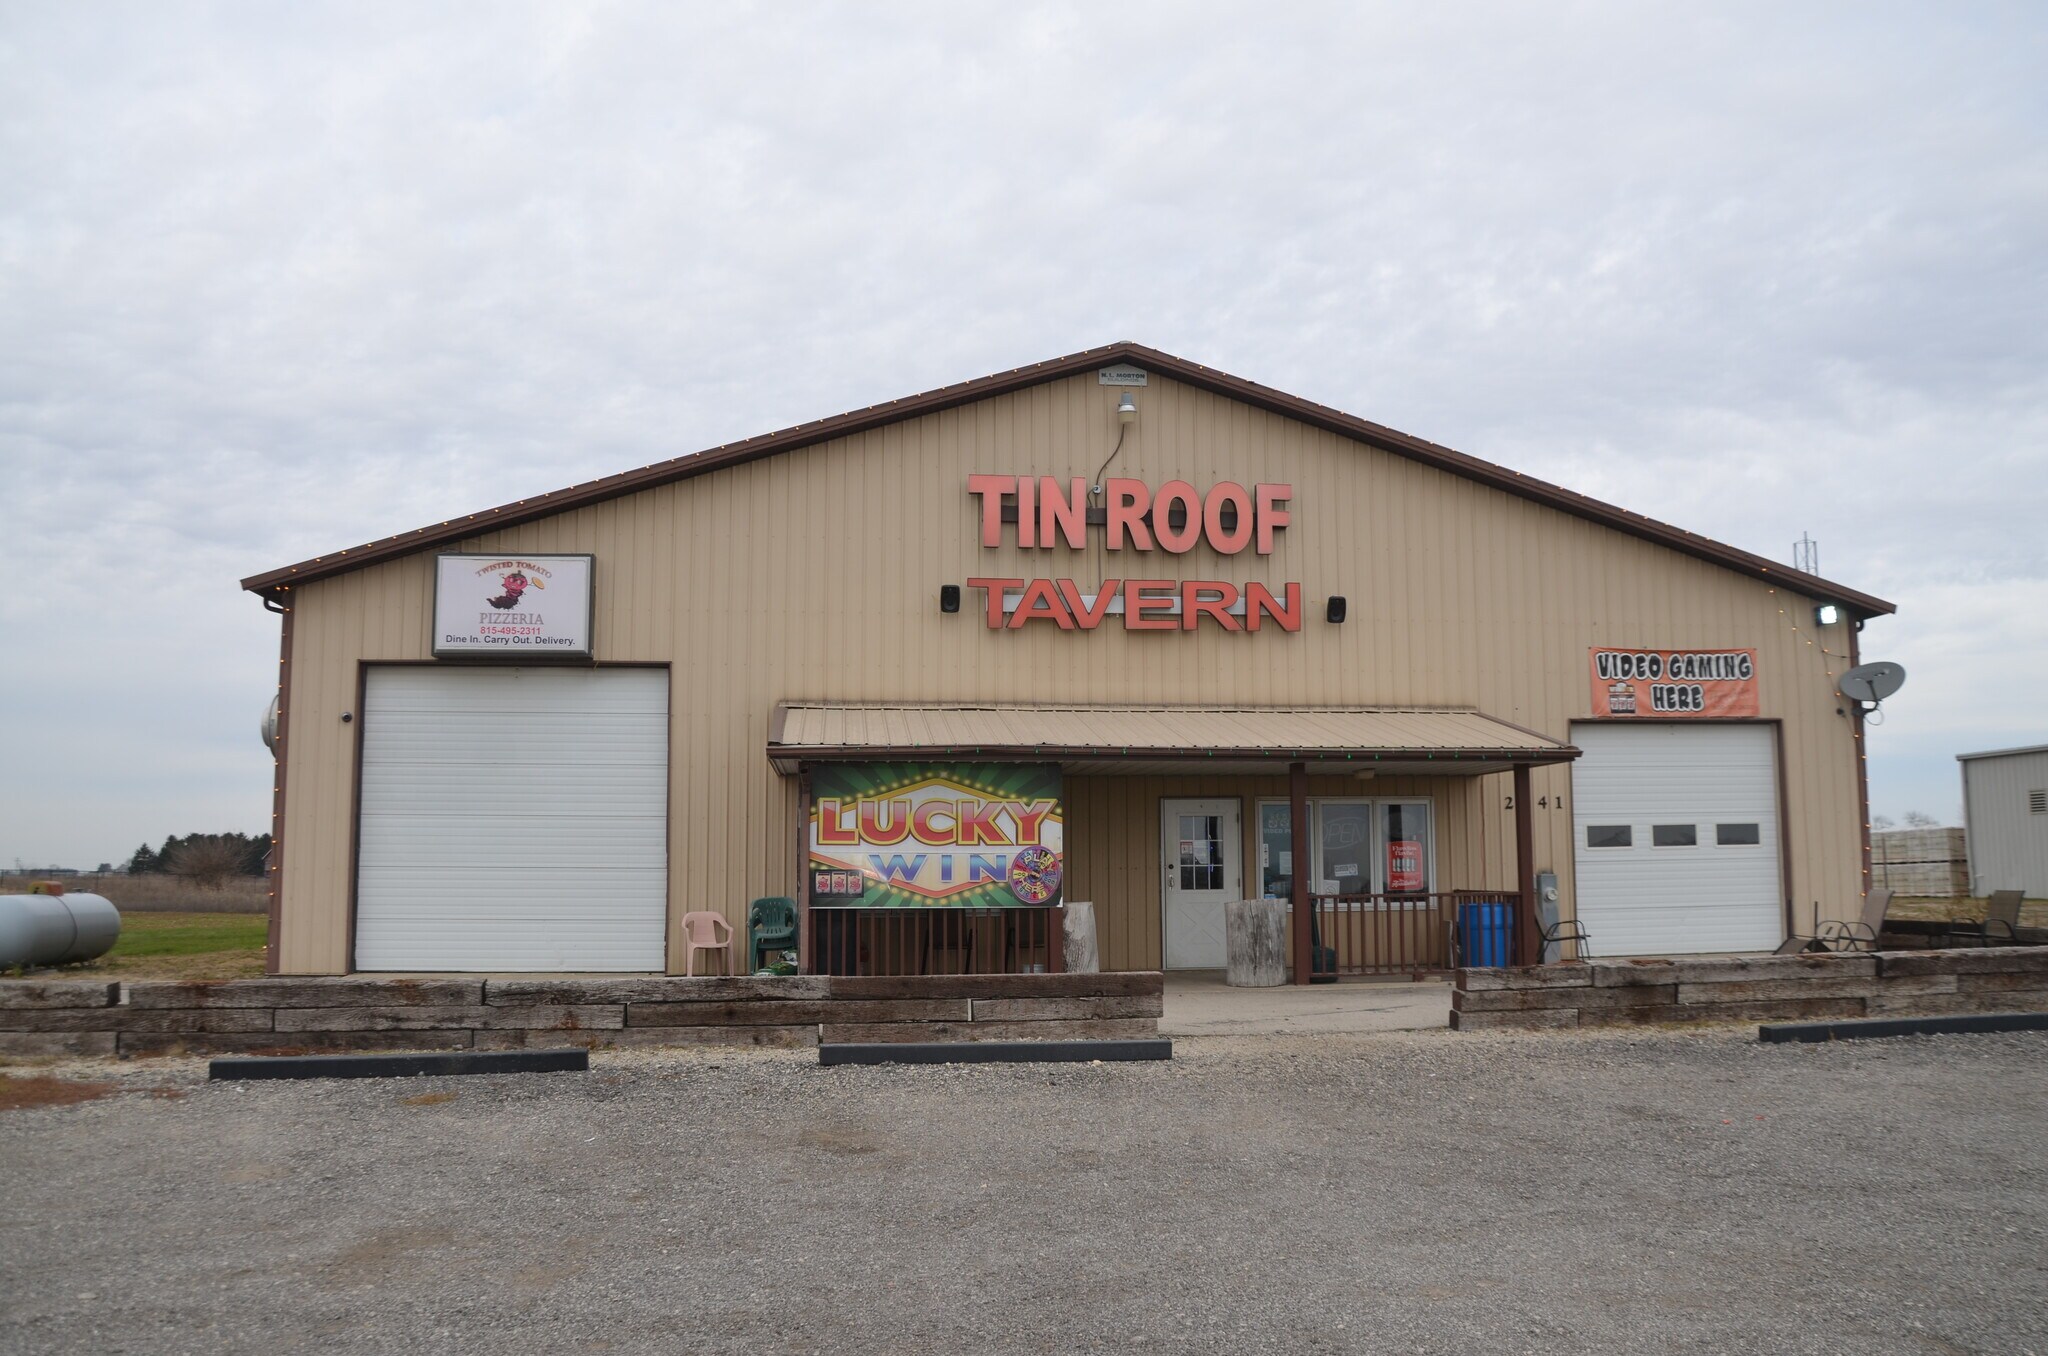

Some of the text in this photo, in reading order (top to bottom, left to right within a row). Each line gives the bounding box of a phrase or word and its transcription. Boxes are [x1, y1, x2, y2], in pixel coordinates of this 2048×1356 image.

[968, 473, 1292, 555] TIN ROOF
[475, 561, 552, 579] TWISTED TOMATO
[479, 612, 544, 625] PIZZERIA
[967, 577, 1301, 632] TAVERN
[446, 635, 575, 646] Dine In. Carry Out. Delivery.
[480, 627, 541, 635] 815-495-2311
[1596, 652, 1753, 680] VIDEO GAMING
[1651, 683, 1705, 712] HERE
[817, 798, 1058, 845] LUCKY
[1324, 823, 1367, 844] PEN
[868, 854, 1008, 882] WIN
